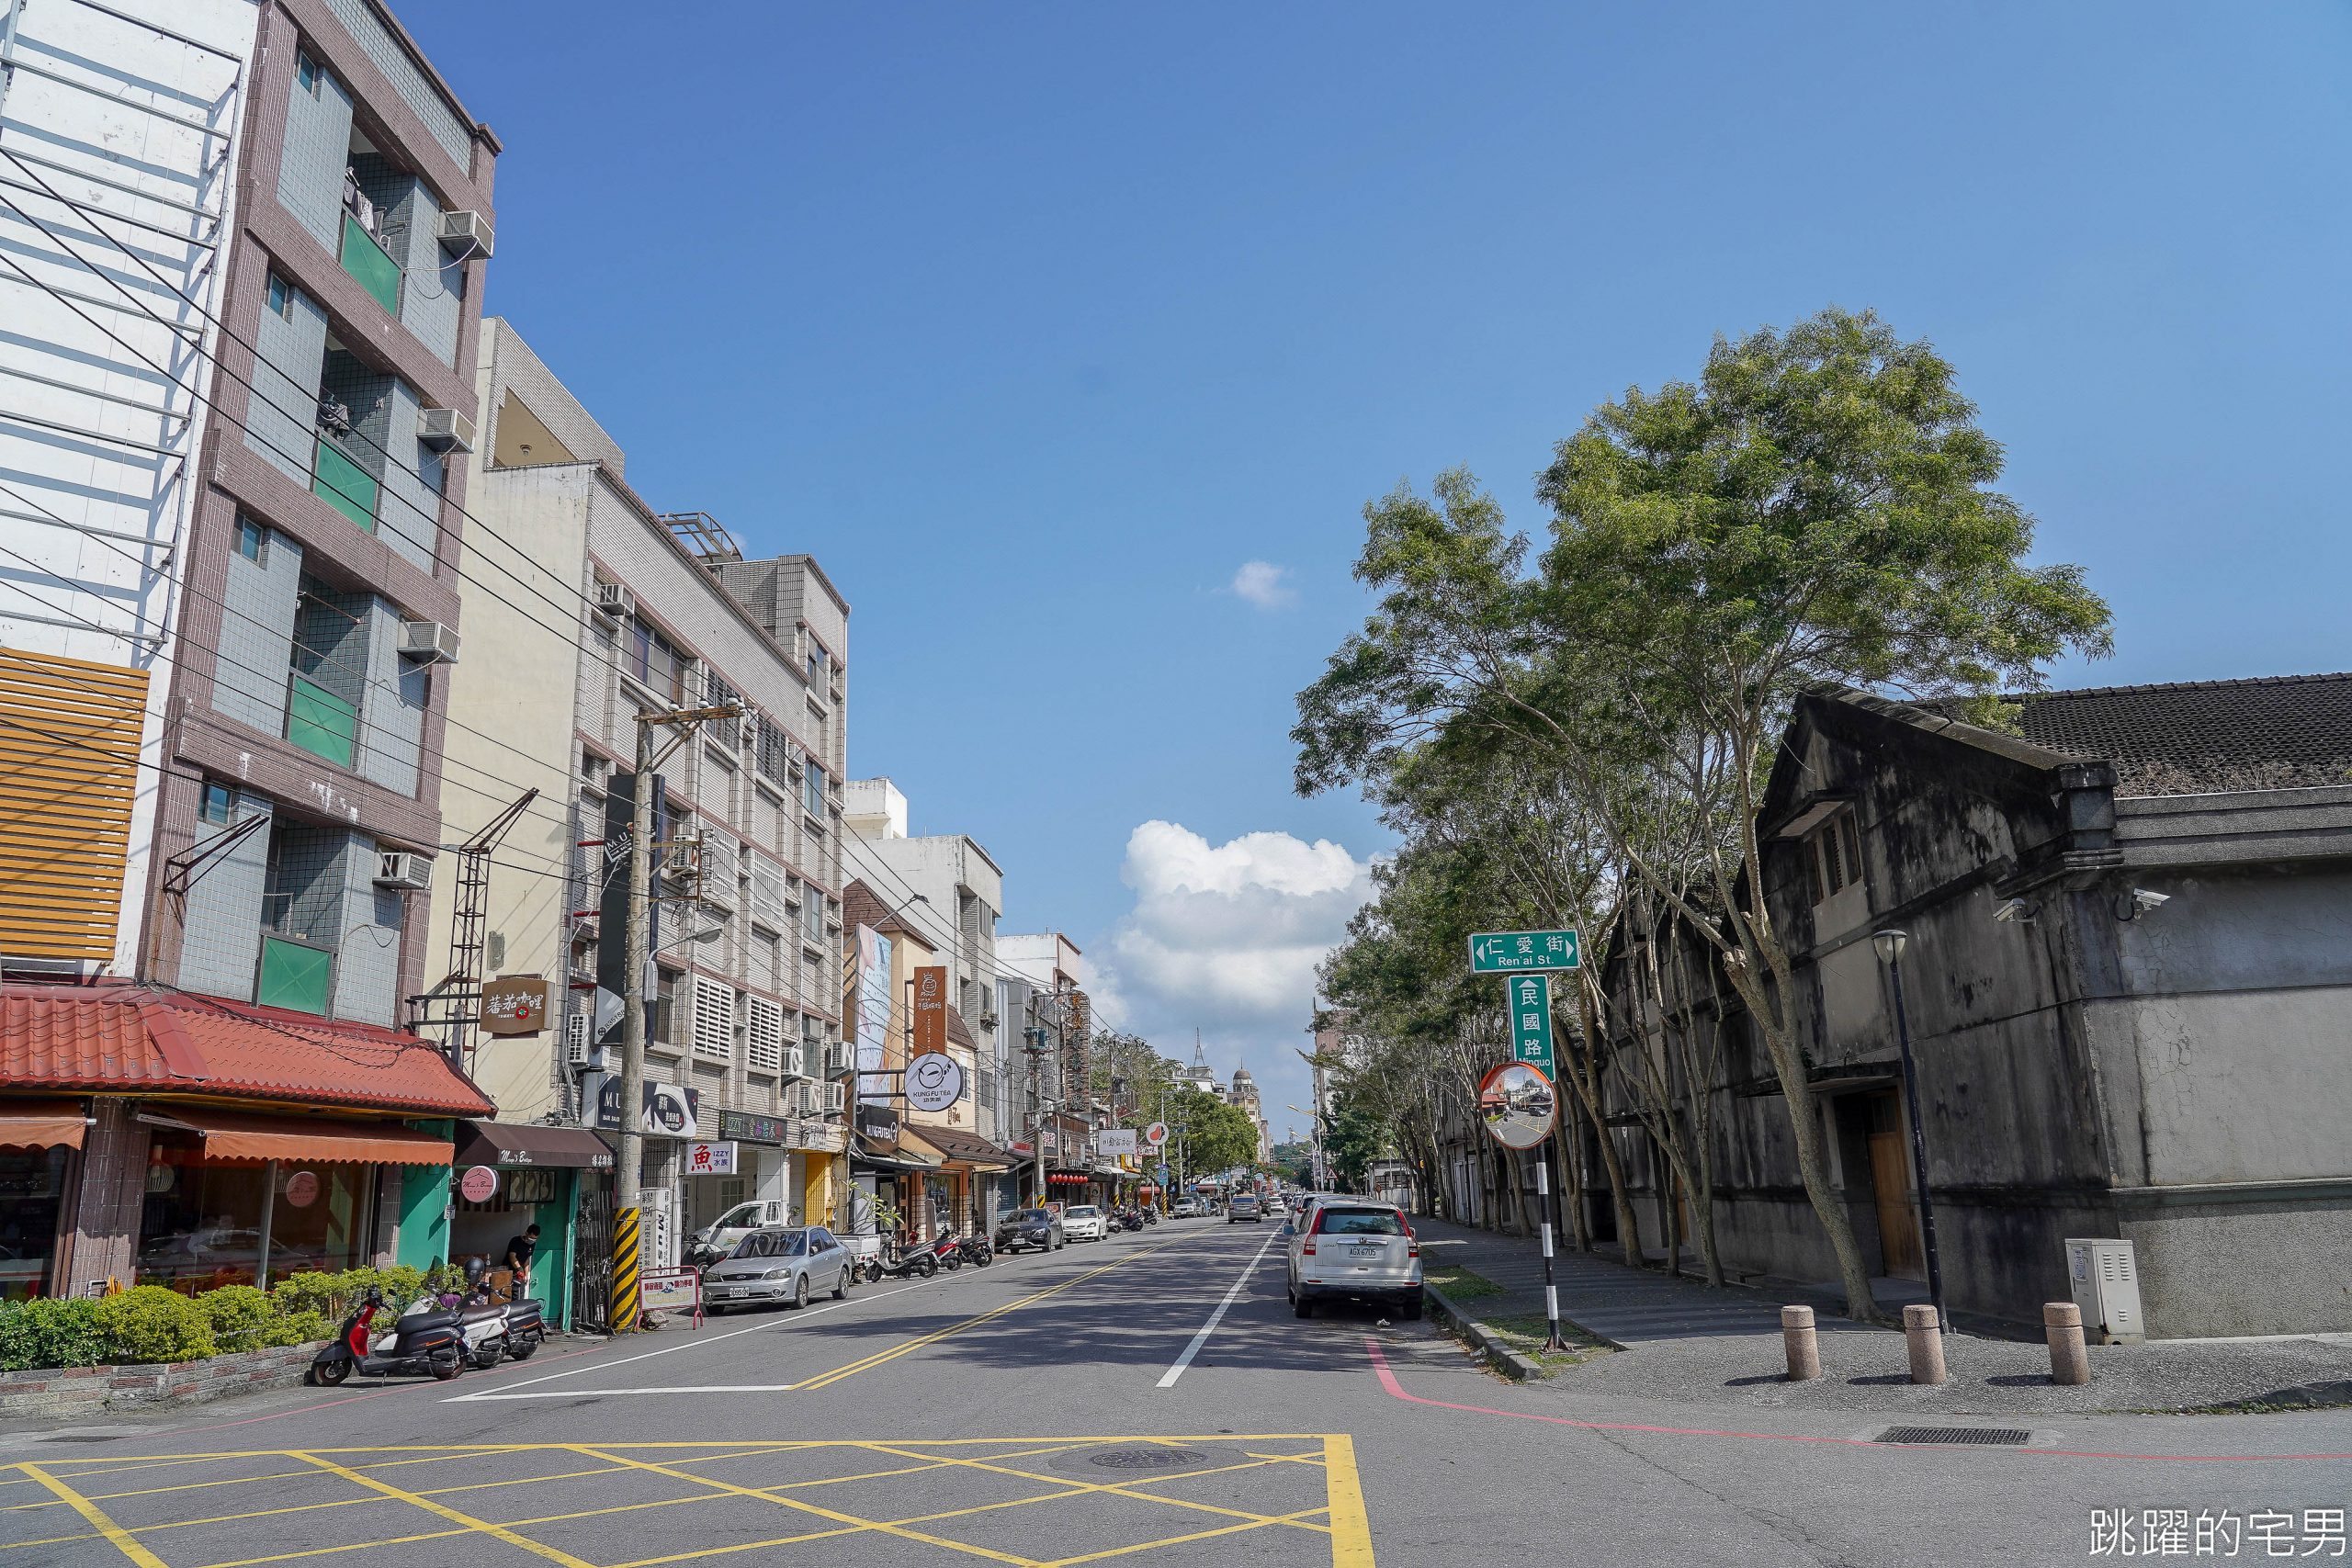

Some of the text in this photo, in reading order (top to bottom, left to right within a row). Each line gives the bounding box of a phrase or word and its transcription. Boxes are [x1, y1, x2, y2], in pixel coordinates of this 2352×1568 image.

[1486, 935, 1564, 955] 仁愛街
[1498, 955, 1555, 966] Ren'ai St.
[485, 991, 544, 1014] 蕃茄咖哩
[1521, 988, 1543, 1055] 民國路
[691, 1145, 713, 1172] 魚
[642, 1192, 653, 1218] 繆斯
[1349, 1248, 1376, 1257] AGX-6705
